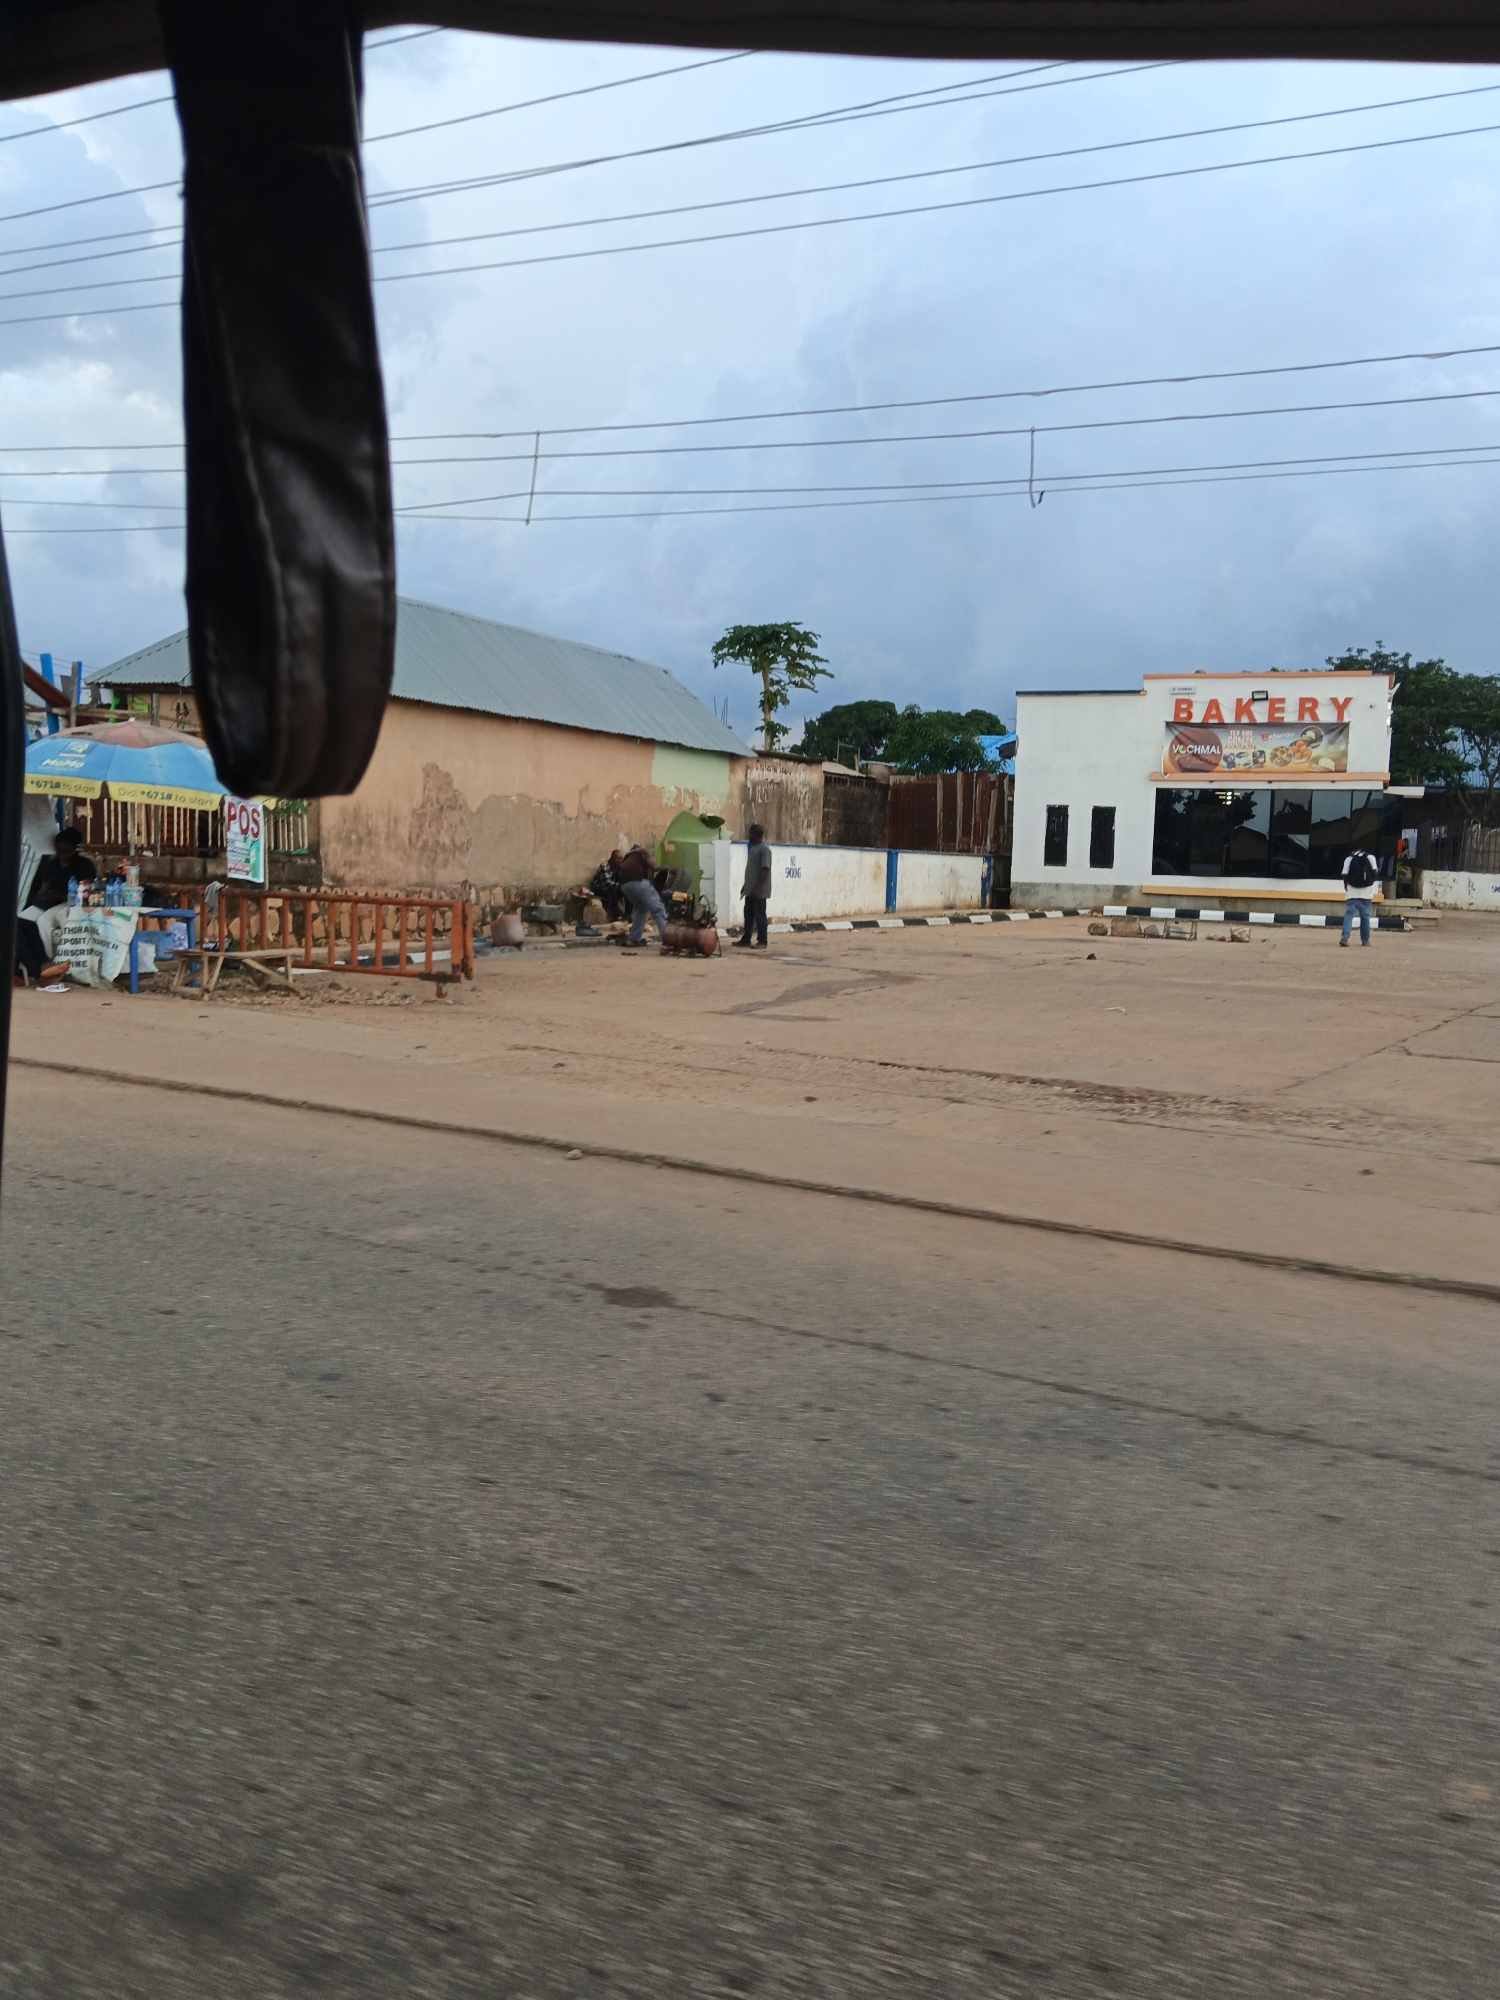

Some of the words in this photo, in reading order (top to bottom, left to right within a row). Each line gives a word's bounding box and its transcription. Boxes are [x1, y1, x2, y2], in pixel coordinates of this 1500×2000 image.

[1173, 697, 1353, 723] BAKERY
[1172, 744, 1221, 754] VOCHMAL
[41, 758, 85, 769] MoMo
[175, 794, 186, 803] to
[188, 796, 214, 806] start
[227, 801, 260, 839] POS
